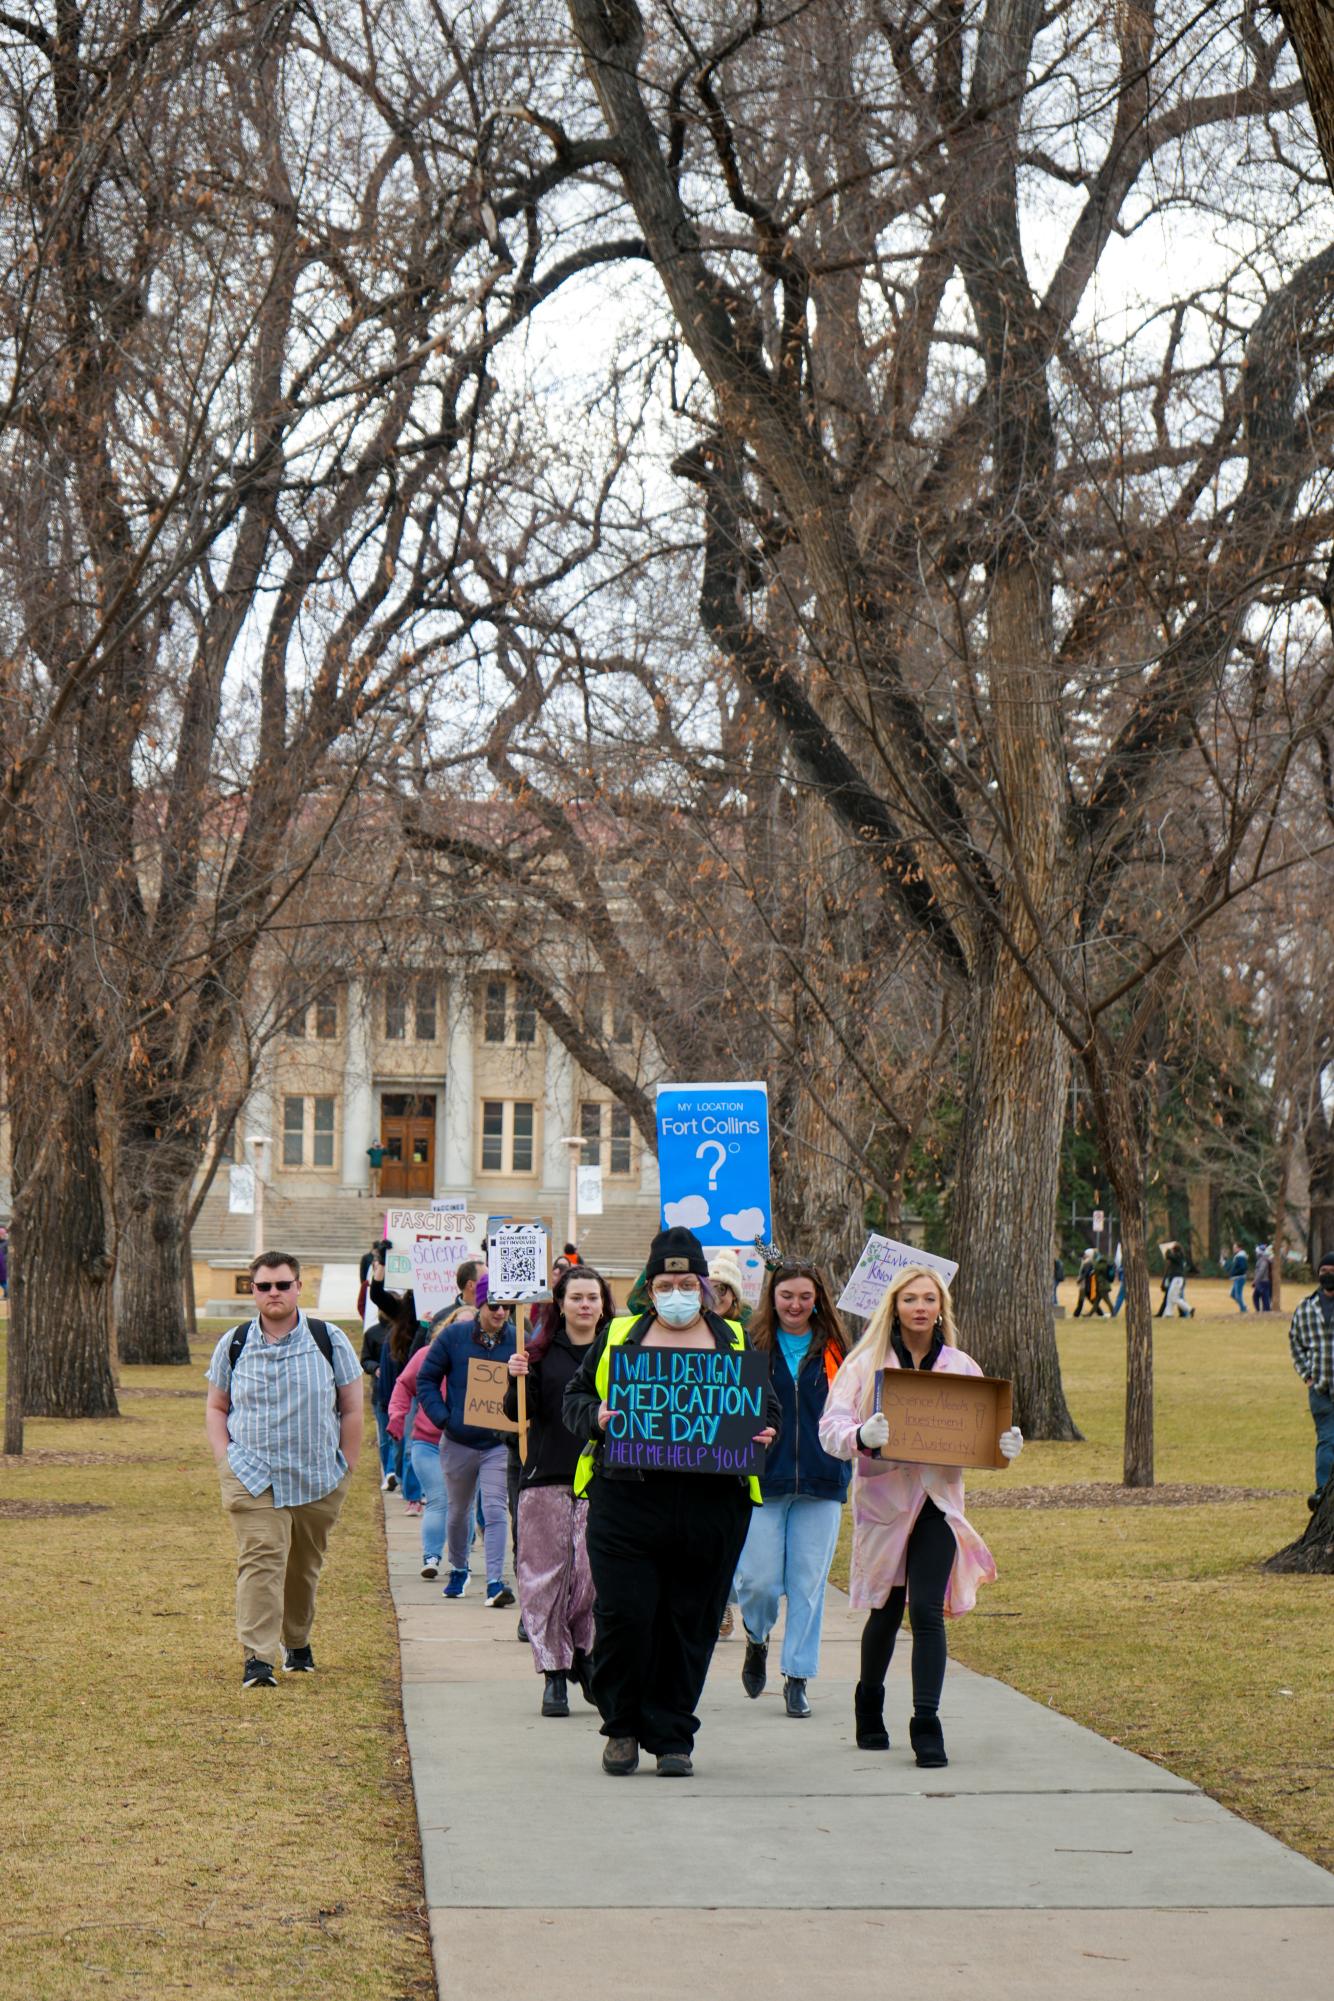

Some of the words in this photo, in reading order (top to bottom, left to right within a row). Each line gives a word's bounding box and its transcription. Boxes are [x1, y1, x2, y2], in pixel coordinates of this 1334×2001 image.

[677, 1103, 692, 1111] MY
[696, 1102, 744, 1111] LOCATION
[661, 1117, 698, 1136] Fort
[701, 1116, 760, 1135] Collins
[391, 1211, 476, 1233] FASCISTS
[413, 1243, 469, 1264] Science
[614, 1352, 621, 1381] I
[622, 1352, 669, 1382] WILL
[671, 1352, 742, 1386] DESIGN
[609, 1383, 763, 1417] MEDICATION
[608, 1409, 665, 1440] ONE
[670, 1413, 721, 1445] DAY
[609, 1440, 645, 1466] HELP
[645, 1445, 667, 1467] ME
[667, 1445, 708, 1468] HELP
